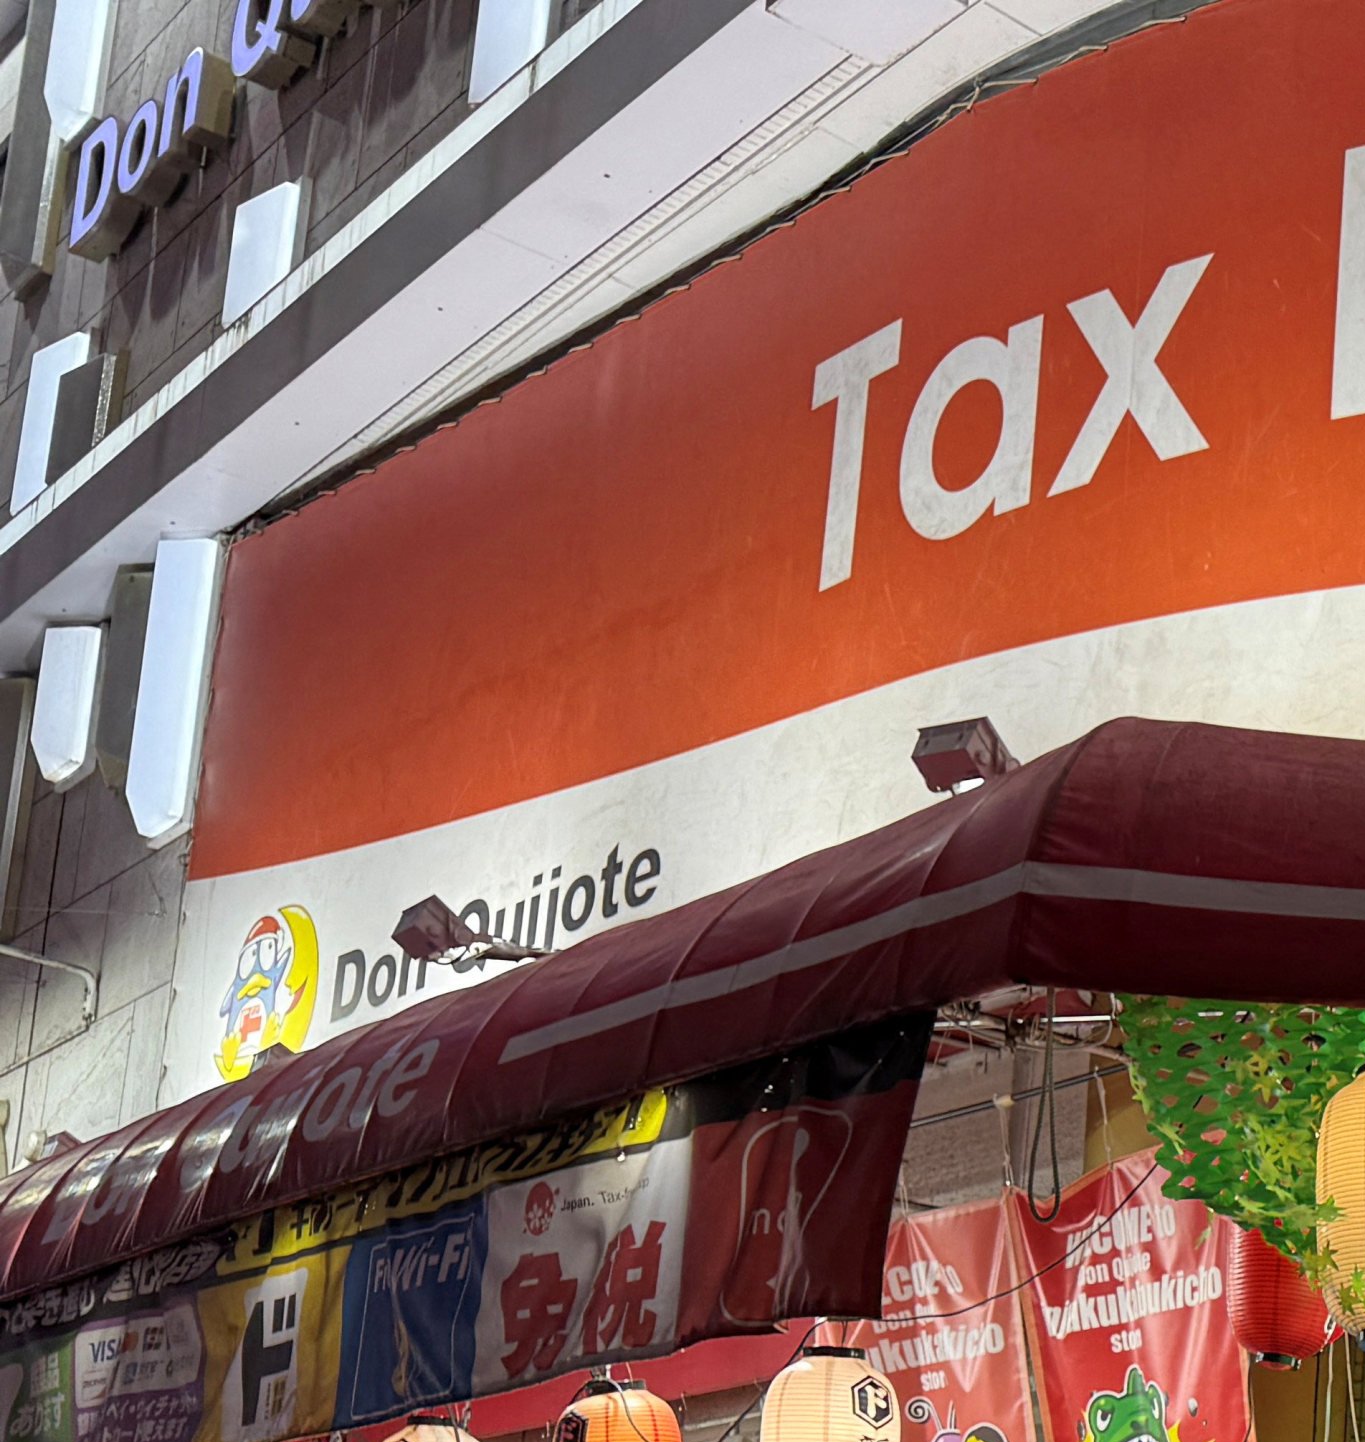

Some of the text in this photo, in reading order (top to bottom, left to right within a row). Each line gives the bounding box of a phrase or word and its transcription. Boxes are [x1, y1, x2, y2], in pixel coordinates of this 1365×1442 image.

[70, 47, 204, 247] Don
[811, 253, 1214, 592] Tax
[453, 843, 662, 974] Quijote
[394, 1230, 470, 1290] Wi-Fi
[500, 1220, 666, 1379] 免税
[242, 1292, 298, 1428] ド
